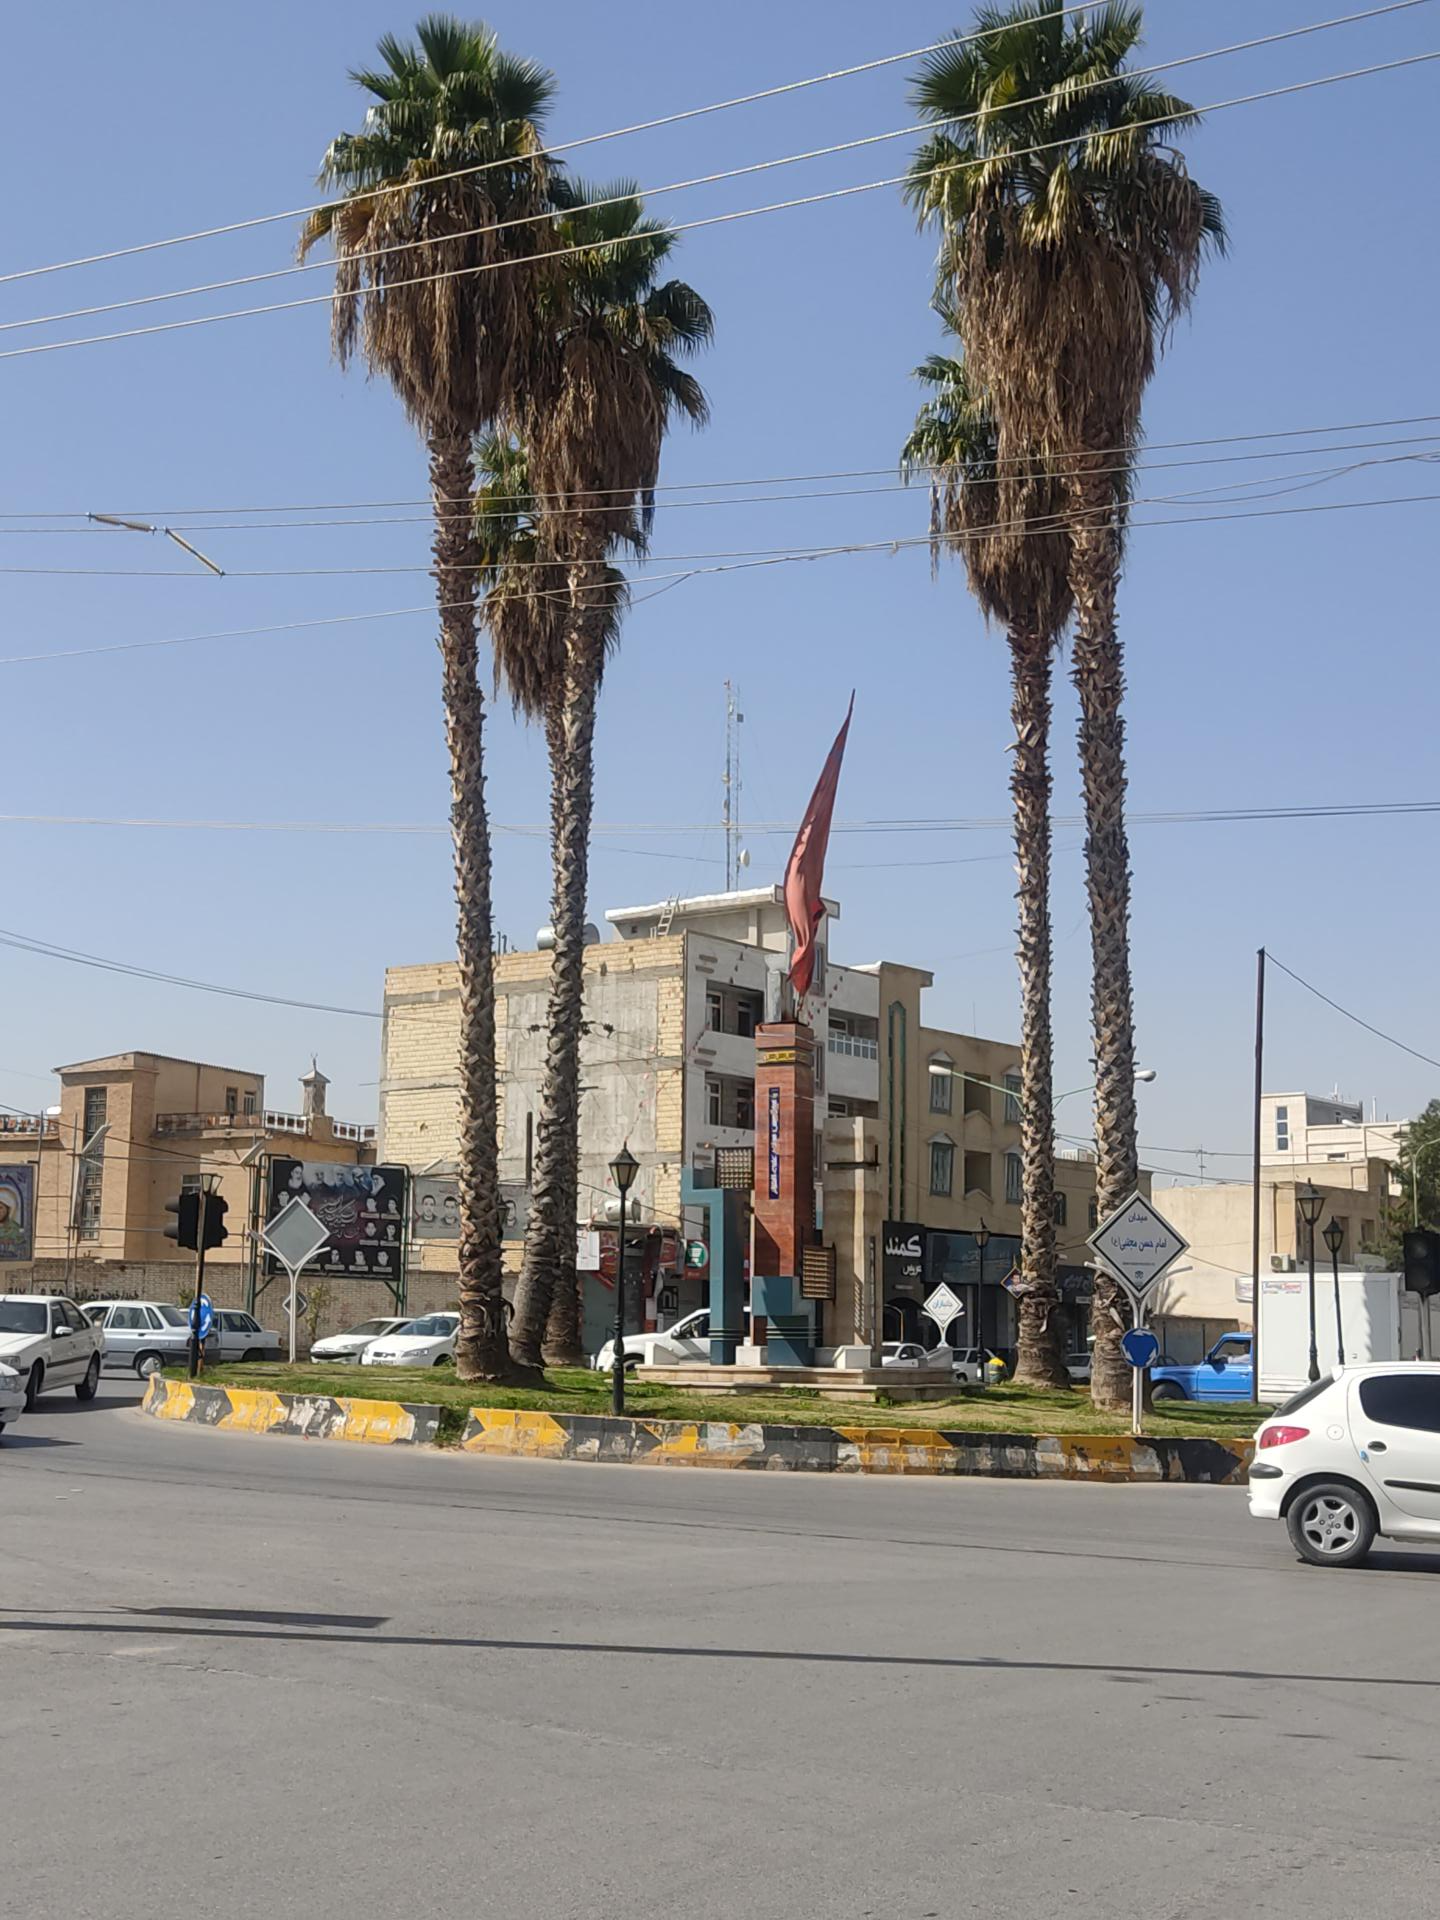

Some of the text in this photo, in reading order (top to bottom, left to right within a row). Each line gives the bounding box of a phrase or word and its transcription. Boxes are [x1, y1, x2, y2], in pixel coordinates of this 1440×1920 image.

[1128, 1212, 1148, 1223] میدان
[885, 1235, 922, 1257] کمند
[1138, 1241, 1154, 1252] حسن
[1155, 1238, 1167, 1253] امام
[902, 1264, 922, 1276] عروس
